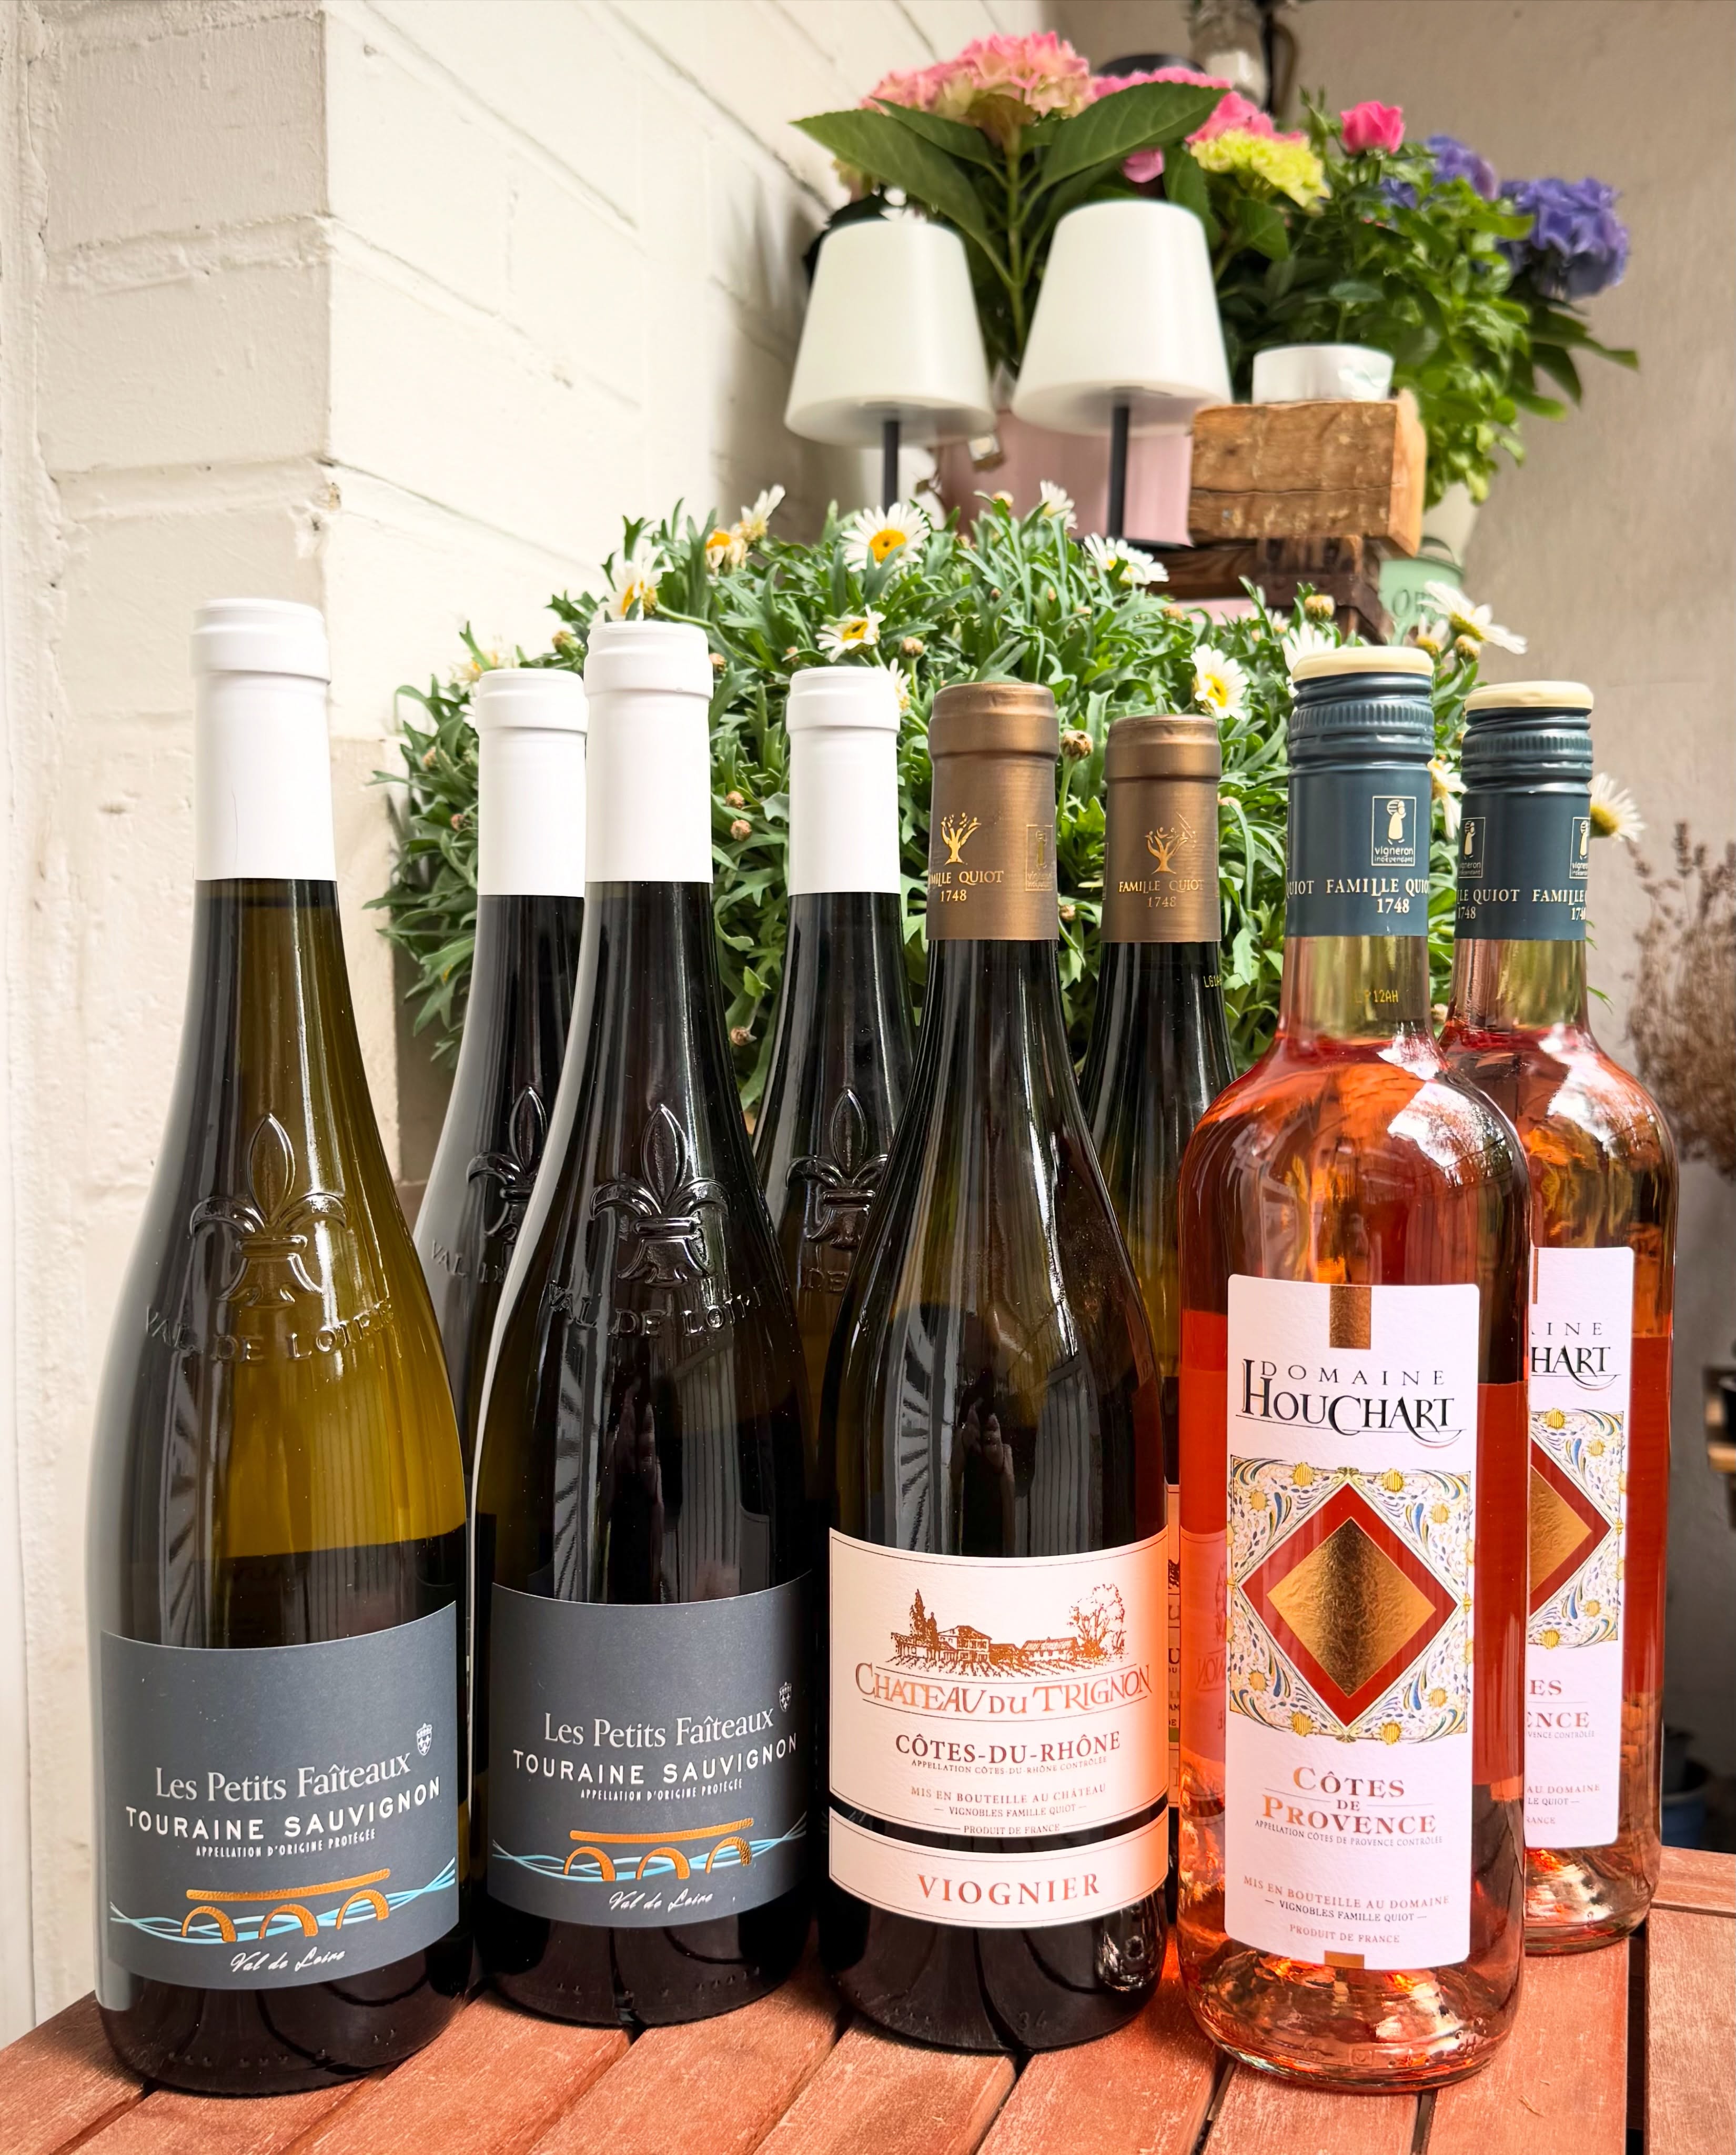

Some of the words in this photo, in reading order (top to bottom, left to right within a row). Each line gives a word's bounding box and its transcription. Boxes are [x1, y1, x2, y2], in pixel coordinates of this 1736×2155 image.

[1375, 846, 1414, 857] vigneron
[959, 871, 1004, 885] QUIOT
[1119, 881, 1160, 893] FAMILLE
[1169, 879, 1204, 893] QUIOT
[941, 889, 967, 902] 1748
[1326, 879, 1399, 897] FAMILLE
[1473, 889, 1520, 905] QUIOT
[1531, 889, 1584, 905] FAMILLE
[1147, 897, 1177, 908] 1748
[1377, 898, 1410, 913] 1748
[1532, 1322, 1602, 1335] INE
[1261, 1361, 1445, 1386] DOMAINE
[1241, 1358, 1462, 1444] HOUCHART
[855, 1662, 986, 1715] CHATEAU
[988, 1695, 1027, 1715] DU
[1032, 1664, 1153, 1712] TRIGNON
[544, 1713, 584, 1745] Les
[593, 1718, 667, 1748] Petits
[676, 1708, 774, 1746] Faîteaux
[895, 1730, 1121, 1765] CÔTES-DU-RHÔNE
[513, 1749, 644, 1785] TOURAINE
[663, 1733, 797, 1783] SAUVIGNON
[911, 1759, 972, 1774] APPELLATION
[1060, 1756, 1108, 1772] CONTRÔLÉE
[155, 1767, 197, 1801] Les
[208, 1771, 287, 1802] Petits
[298, 1751, 411, 1798] Faîteaux
[1293, 1766, 1405, 1799] CÔTES
[580, 1789, 641, 1801] APPELLATION
[647, 1787, 697, 1801] D'ORIGINE
[911, 1786, 932, 1798] MIS
[936, 1790, 952, 1800] EN
[956, 1793, 1027, 1804] BOUTEILLE
[1032, 1793, 1049, 1802] AU
[1053, 1783, 1107, 1800] CHÂTEAU
[1547, 1784, 1600, 1794] DOMAINE
[126, 1806, 264, 1840] TOURAINE
[284, 1776, 441, 1838] SAUVIGNON
[948, 1806, 1004, 1817] VIGNOBLES
[1006, 1806, 1047, 1817] FAMILLE
[1049, 1803, 1076, 1816] QUIOT
[1336, 1799, 1360, 1811] DE
[1542, 1798, 1569, 1806] QUIOT
[1261, 1794, 1437, 1835] PROVENCE
[963, 1825, 1006, 1835] PRODUIT
[1008, 1825, 1022, 1835] DE
[1024, 1823, 1061, 1834] FRANCE
[1255, 1819, 1305, 1838] APPELLATION
[1307, 1831, 1334, 1843] CÔTES
[1336, 1836, 1348, 1845] DE
[1350, 1837, 1394, 1847] PROVENCE
[196, 1845, 262, 1858] APPELLATION
[267, 1839, 323, 1858] D'ORIGINE
[917, 1873, 1100, 1905] VIOGNIER
[1244, 1875, 1264, 1890] MIS
[1267, 1883, 1283, 1895] EN
[1287, 1888, 1361, 1908] BOUTEILLE
[1366, 1898, 1386, 1909] AU
[1389, 1895, 1450, 1910] DOMAINE
[609, 1891, 638, 1911] Val
[643, 1896, 662, 1909] de
[668, 1888, 713, 1912] Loire
[1279, 1899, 1335, 1919] VIGNOBLES
[1337, 1910, 1381, 1922] FAMILLE
[1384, 1913, 1415, 1923] QUIOT
[1289, 1924, 1336, 1940] PRODUIT
[1339, 1932, 1354, 1942] DE
[1358, 1934, 1400, 1943] FRANCE
[230, 1952, 262, 1973] Val
[268, 1954, 288, 1970] de
[295, 1946, 346, 1971] Loire
